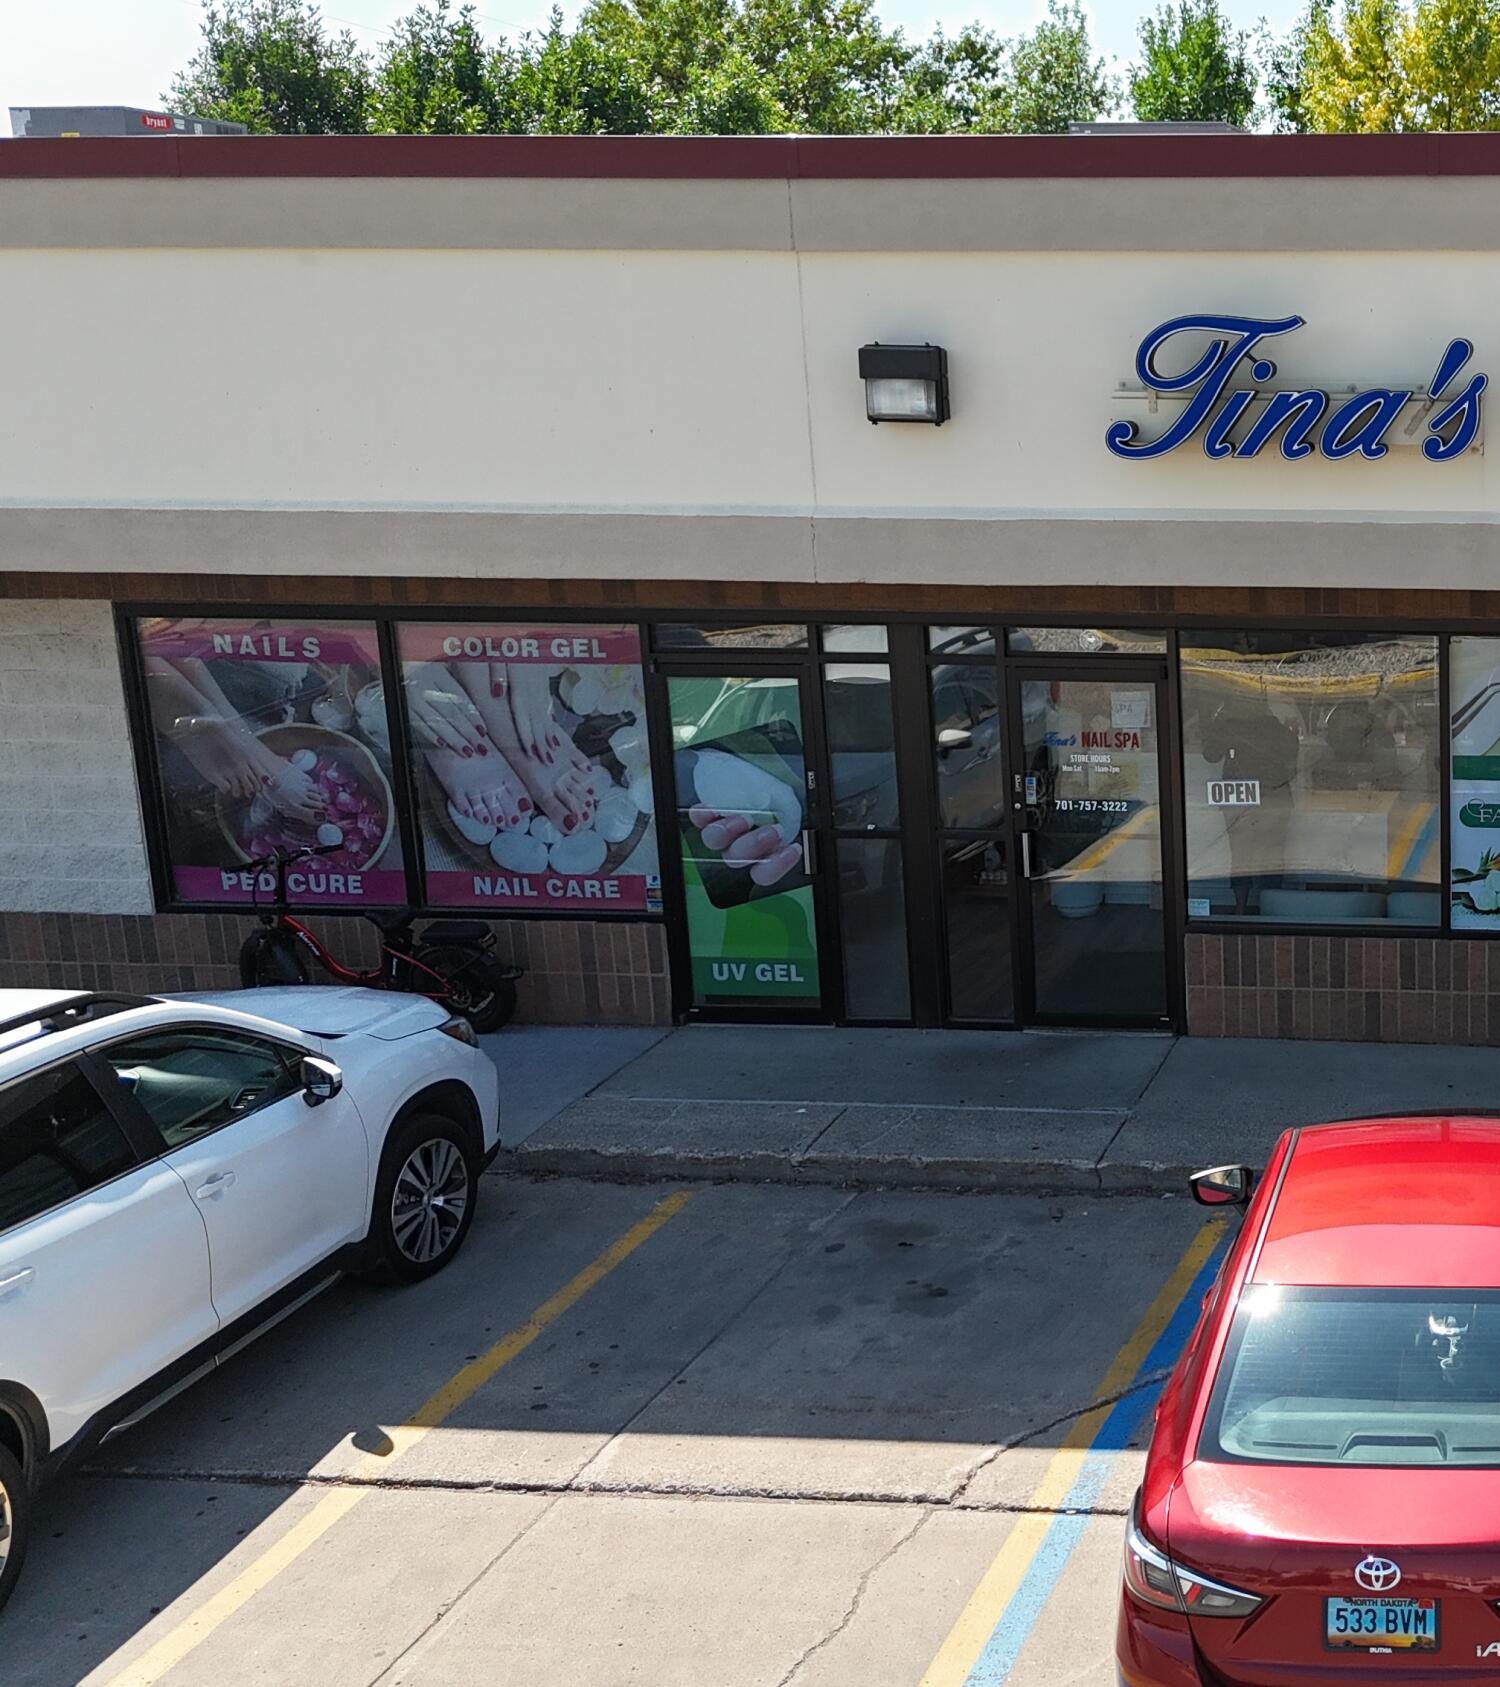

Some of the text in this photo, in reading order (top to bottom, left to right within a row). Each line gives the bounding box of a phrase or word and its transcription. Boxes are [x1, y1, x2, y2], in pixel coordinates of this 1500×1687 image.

[1105, 313, 1489, 461] Tina's
[213, 634, 321, 658] NAILS
[443, 637, 607, 658] COLOR GEL
[1081, 732, 1111, 748] NAIL
[1114, 732, 1140, 748] SPA
[1070, 754, 1111, 763] STORE HOURS
[1211, 783, 1257, 803] OPEN
[1055, 800, 1128, 811] 701-757-3222
[220, 872, 364, 894] PEDCURE
[473, 876, 621, 898] NAIL CARE
[712, 963, 804, 982] UV GEL
[1350, 1599, 1414, 1608] NORTH DAKOTA
[1336, 1608, 1427, 1634] 533 BVM
